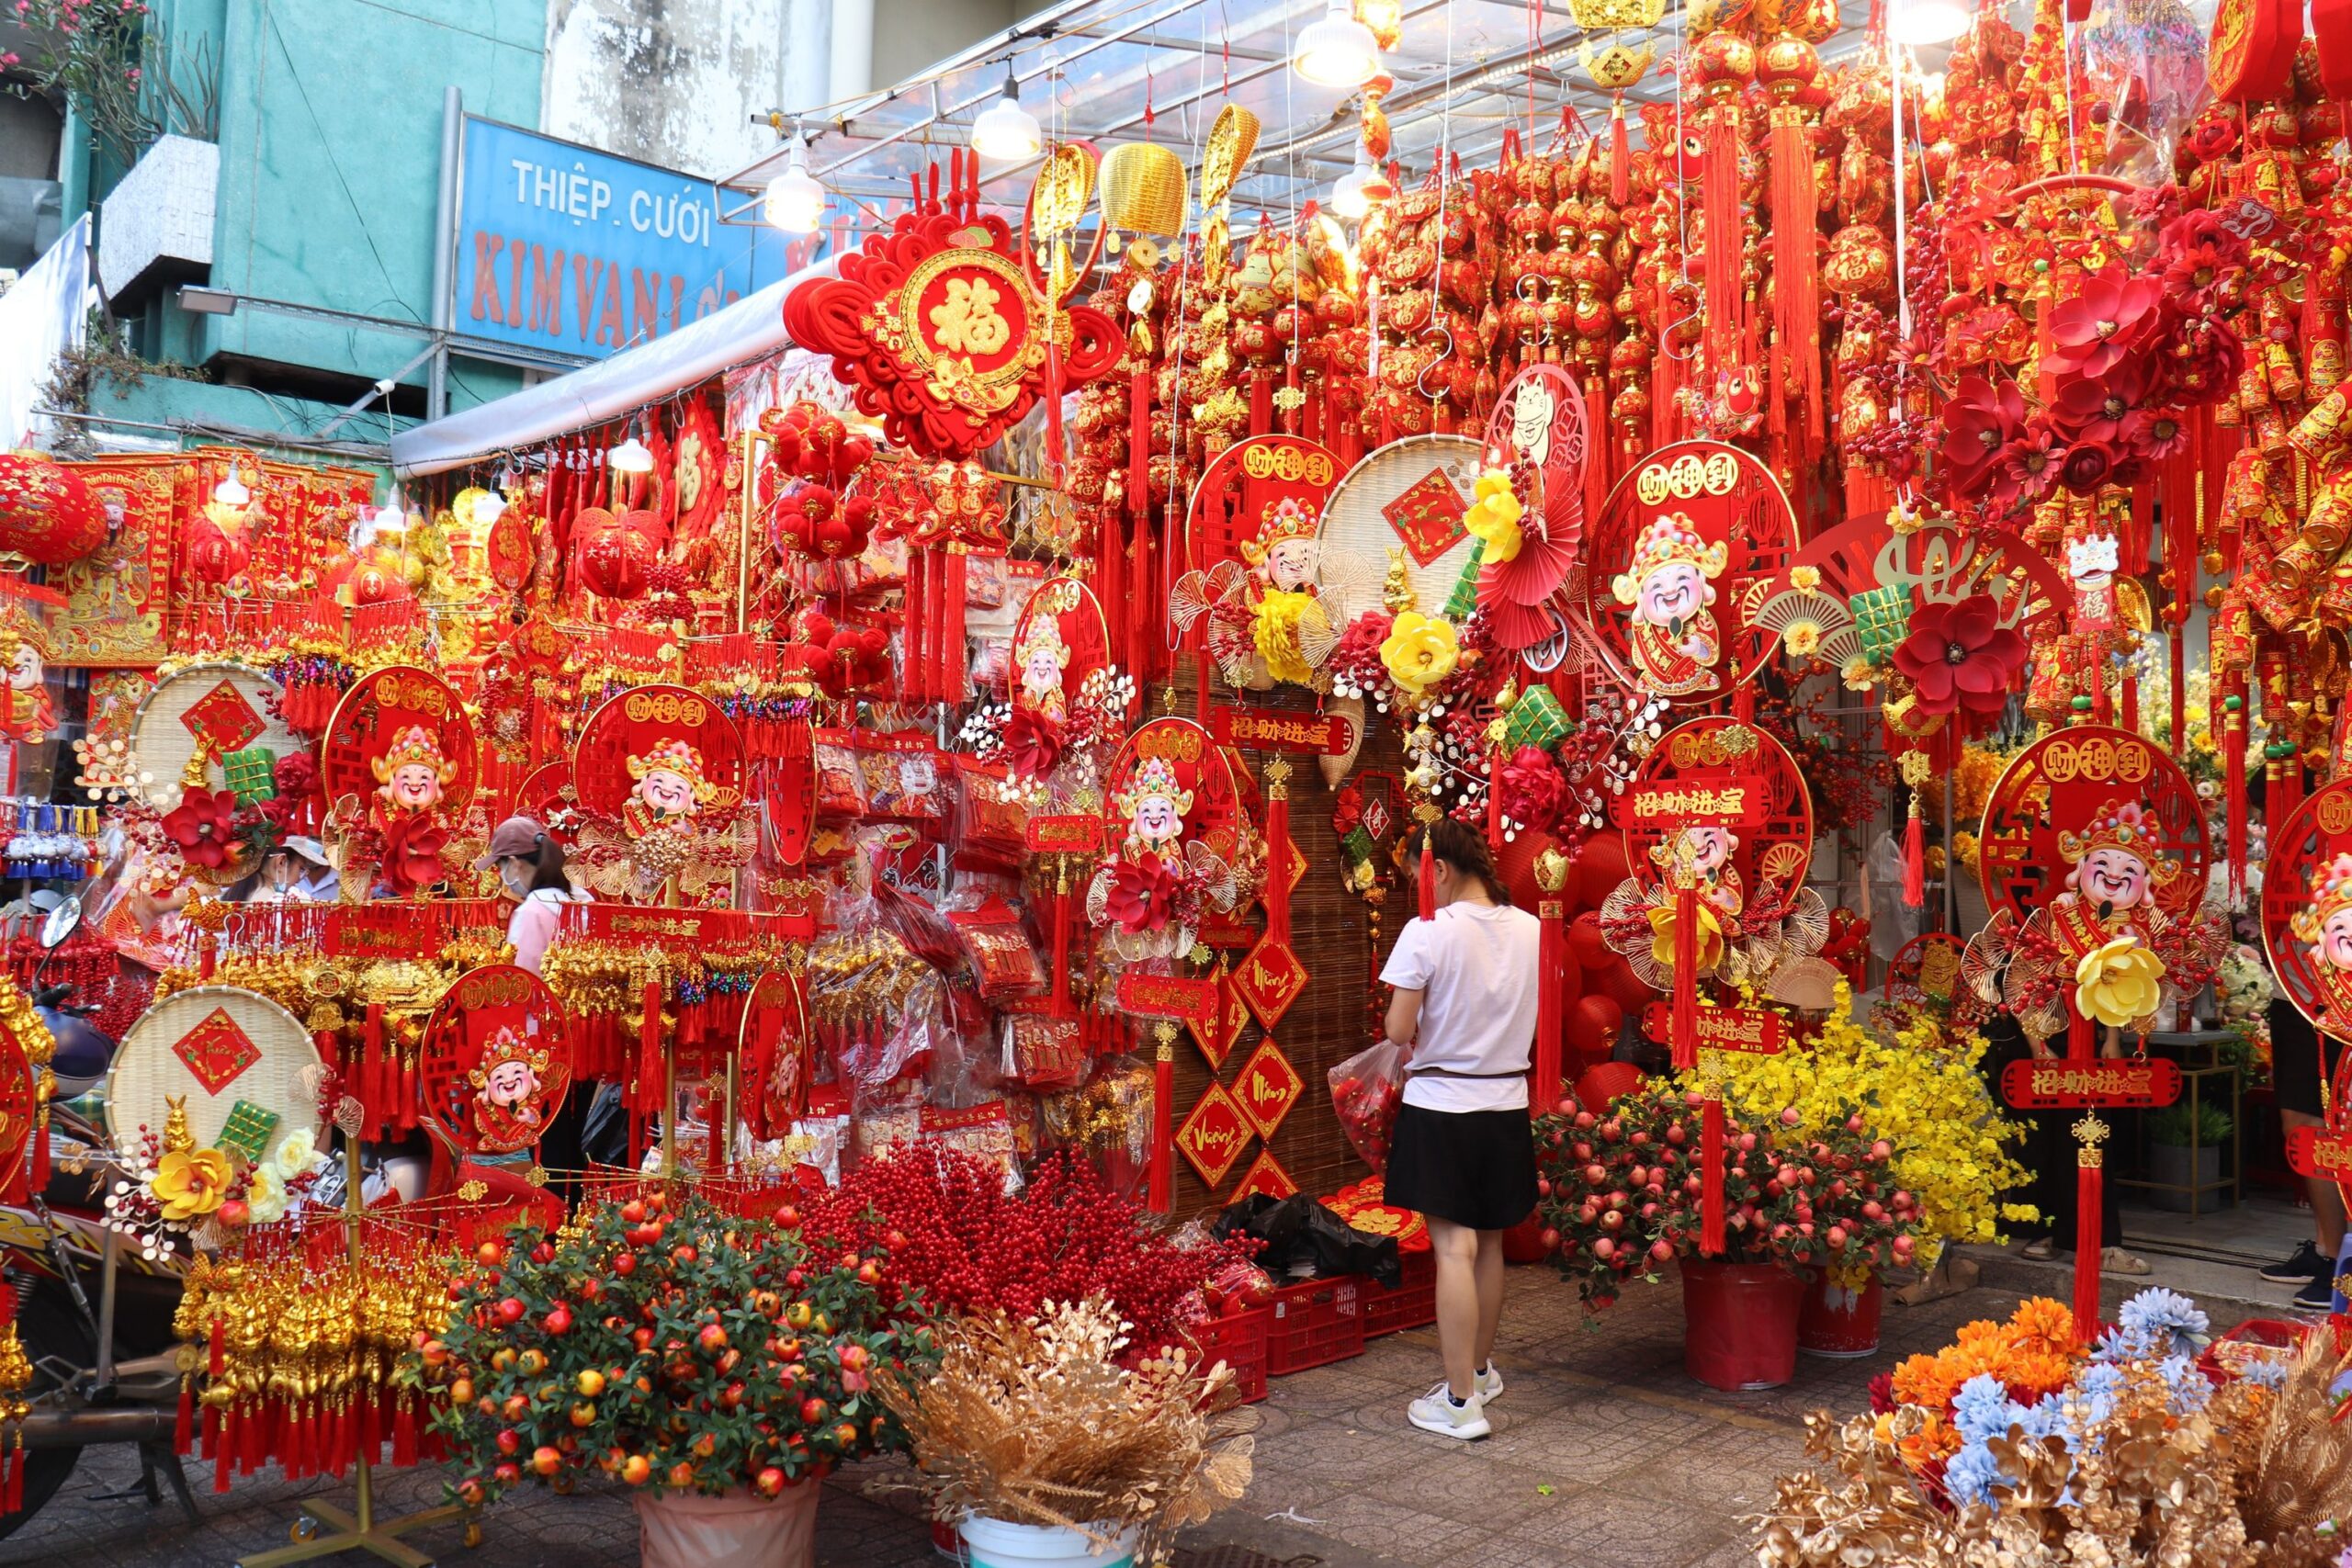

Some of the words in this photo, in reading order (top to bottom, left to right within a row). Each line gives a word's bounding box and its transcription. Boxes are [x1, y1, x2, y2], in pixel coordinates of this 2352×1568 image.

[511, 159, 612, 226] THIỆP
[629, 185, 710, 247] CƯỚI
[470, 230, 566, 337] KIM
[929, 276, 1011, 355] 福
[1243, 444, 1333, 487] 财神到
[1636, 452, 1738, 505] 财神到
[2080, 591, 2109, 619] 福
[625, 694, 707, 727] 财神到
[1230, 716, 1331, 746] 招财进宝
[1669, 728, 1758, 768] 财神
[2042, 737, 2151, 783] 财神到
[1634, 787, 1745, 818] 招财进宝
[2031, 1068, 2153, 1095] 招财进宝
[1193, 1116, 1236, 1157] Vượng
